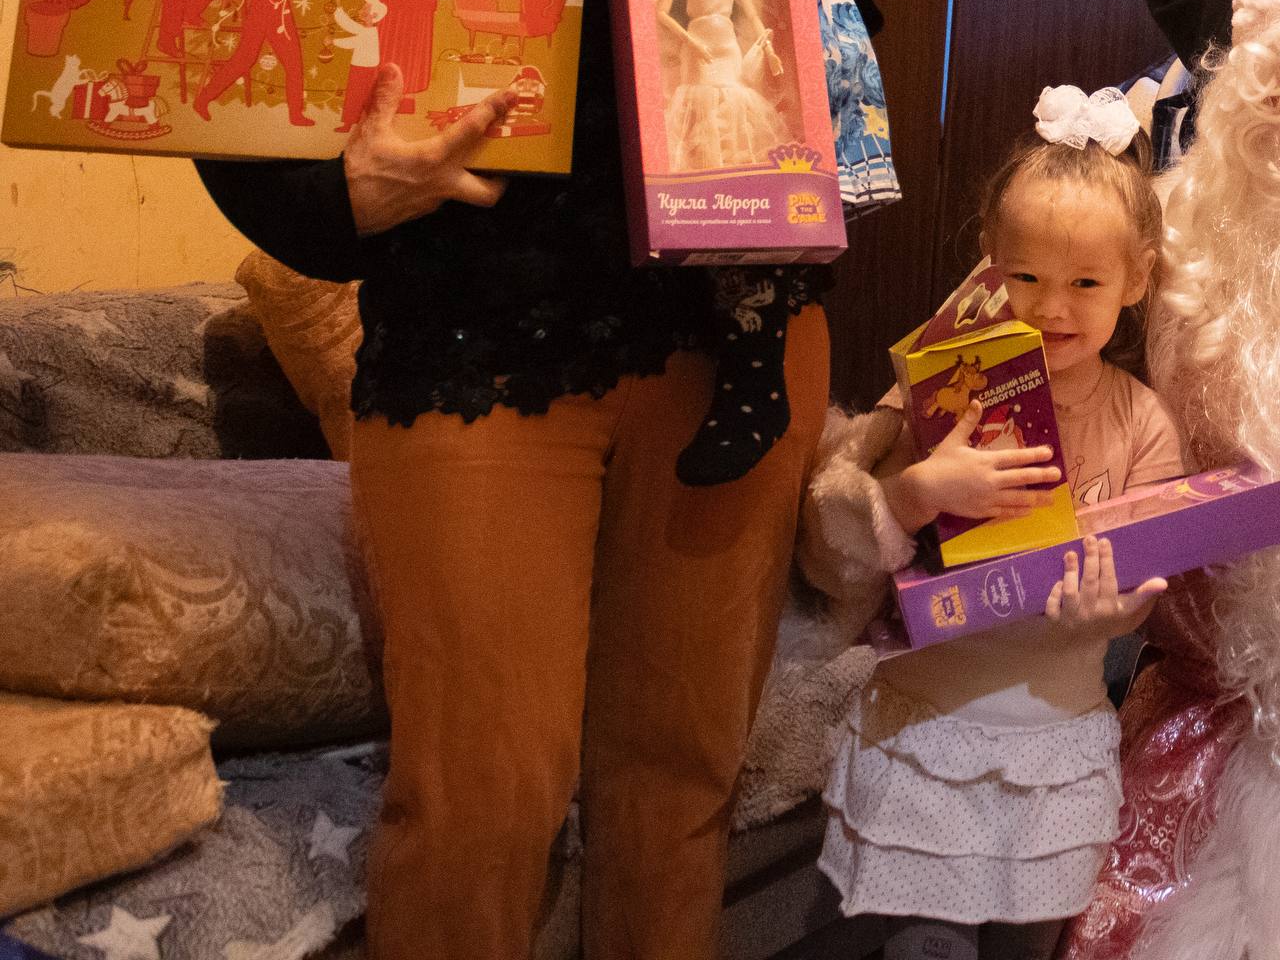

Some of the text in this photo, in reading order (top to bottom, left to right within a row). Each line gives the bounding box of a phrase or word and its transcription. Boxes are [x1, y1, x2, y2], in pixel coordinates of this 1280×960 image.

[657, 192, 771, 216] Кукла Аврора
[786, 193, 823, 207] PLAY
[787, 213, 827, 225] GAME
[978, 369, 1042, 401] СЛАДКИЙ ВАЙБ
[981, 377, 1045, 409] НОВОГО ГОДА!
